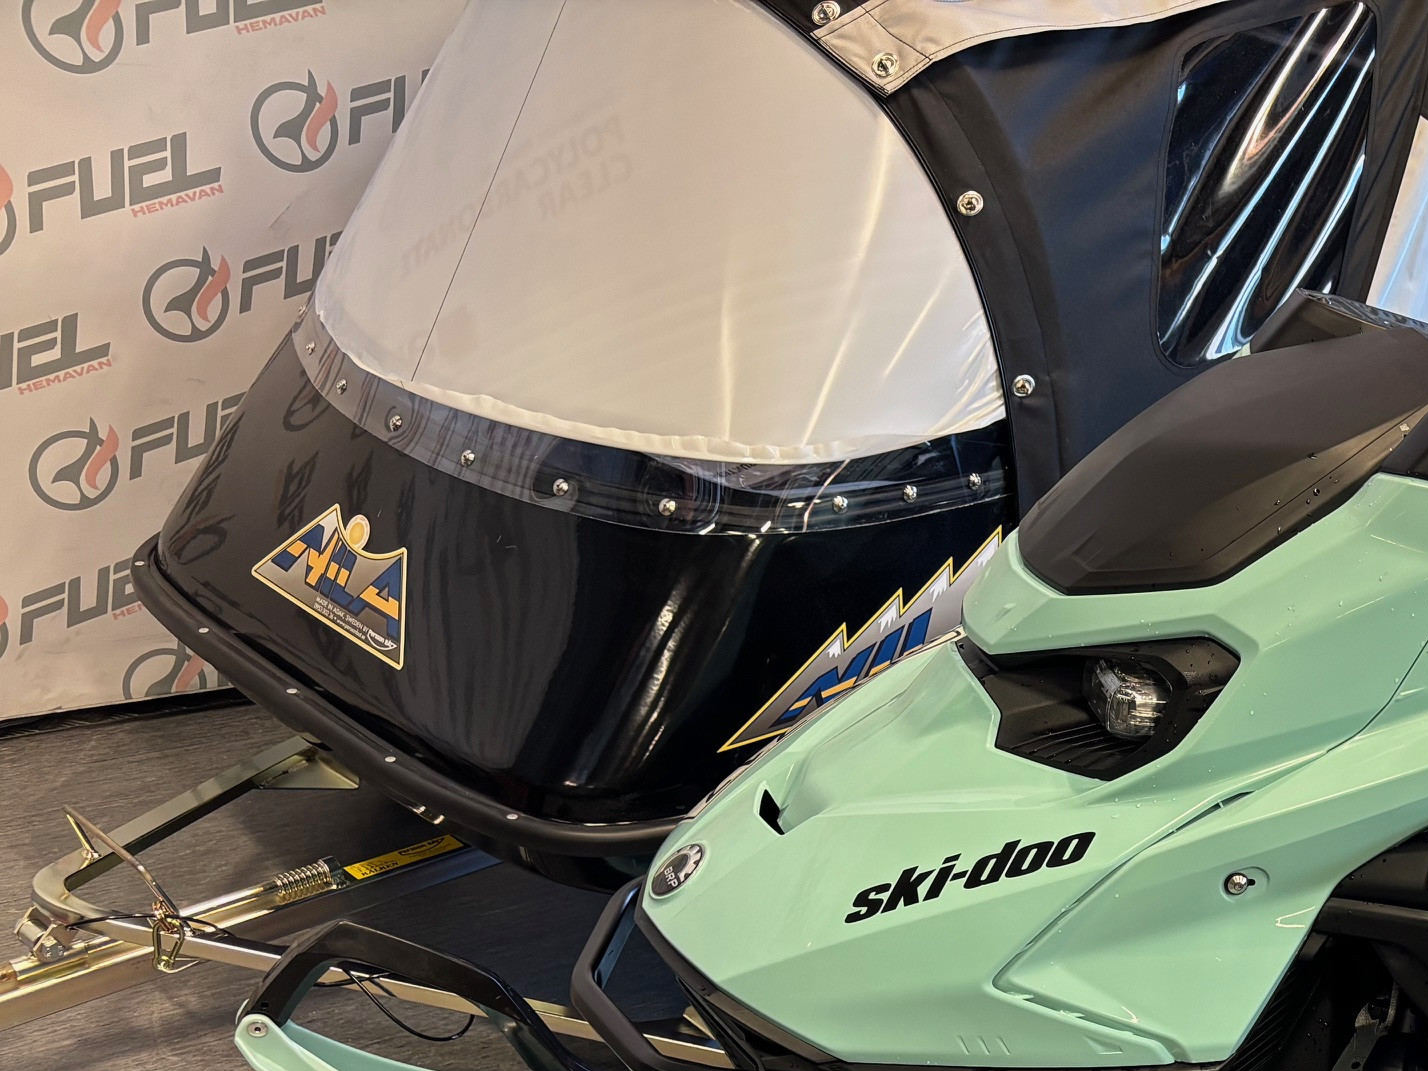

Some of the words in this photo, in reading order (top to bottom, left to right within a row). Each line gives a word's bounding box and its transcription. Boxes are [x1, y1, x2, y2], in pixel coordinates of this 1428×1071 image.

[234, 5, 327, 36] HEMAVAN
[26, 131, 222, 234] FUEL
[131, 184, 224, 219] HEMAVAN
[17, 358, 113, 395] HEMAVAN
[315, 596, 328, 609] MADE
[664, 866, 679, 887] BRP
[844, 831, 1096, 924] ski-doo
